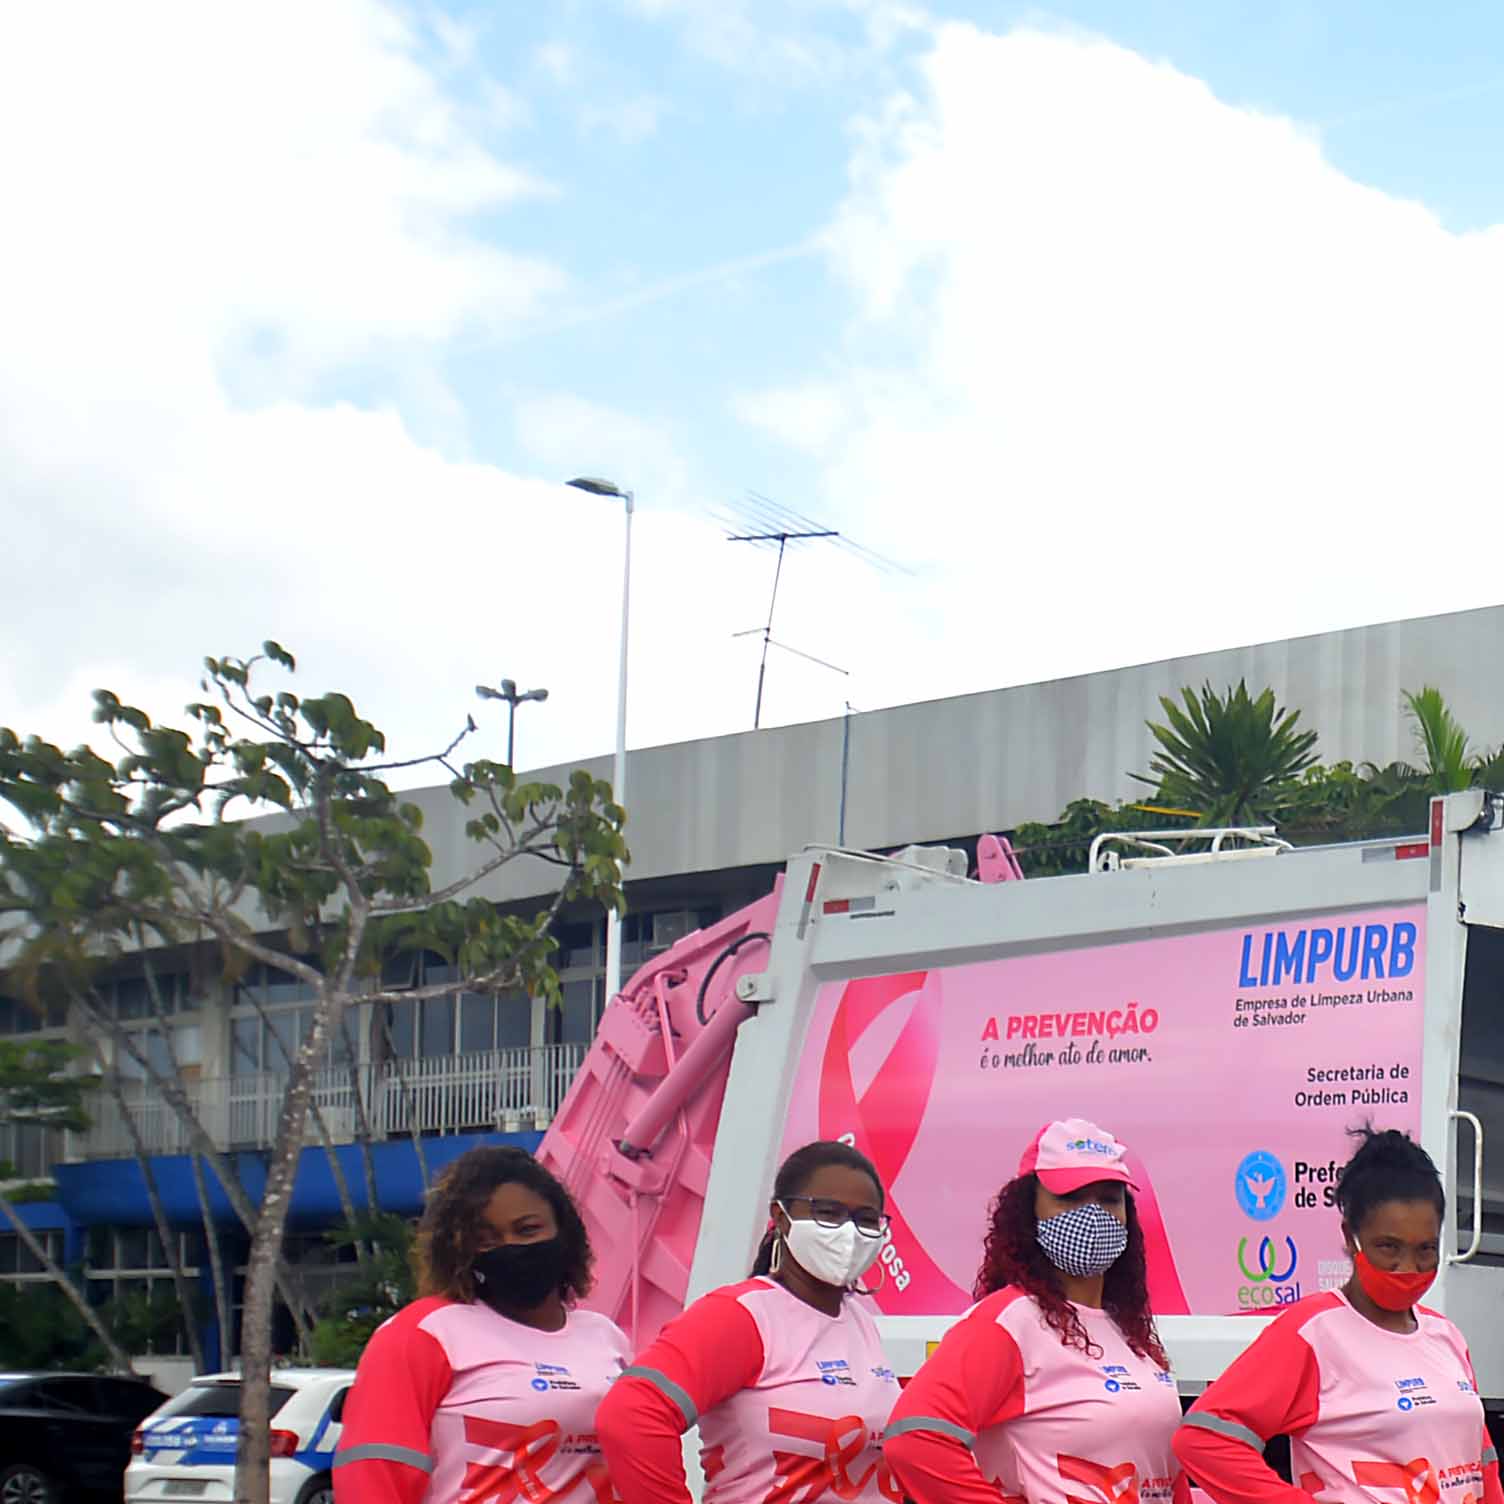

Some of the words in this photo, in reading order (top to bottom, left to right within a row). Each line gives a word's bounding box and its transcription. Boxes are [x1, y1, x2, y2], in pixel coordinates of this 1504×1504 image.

[1238, 921, 1417, 988] LIMPURB
[1235, 998, 1288, 1013] Empresa
[1291, 994, 1307, 1008] de
[1310, 992, 1363, 1009] Limpeza
[1367, 988, 1414, 1004] Urbana
[981, 1016, 999, 1041] A
[1006, 1002, 1159, 1040] PREVENÇÃO
[1233, 1014, 1249, 1028] de
[1252, 1011, 1307, 1028] Salvador
[980, 1047, 989, 1069] é
[991, 1055, 1000, 1068] o
[1003, 1042, 1054, 1068] melhor
[1058, 1041, 1082, 1065] ato
[1086, 1039, 1104, 1064] de
[1108, 1047, 1152, 1064] amor.
[1307, 1064, 1385, 1083] Secretaria
[1389, 1063, 1410, 1080] de
[1294, 1090, 1347, 1107] Ordem
[1351, 1088, 1409, 1105] Pública
[1294, 1187, 1318, 1208] de
[1323, 1187, 1343, 1208] S
[1238, 1281, 1301, 1306] ecosal
